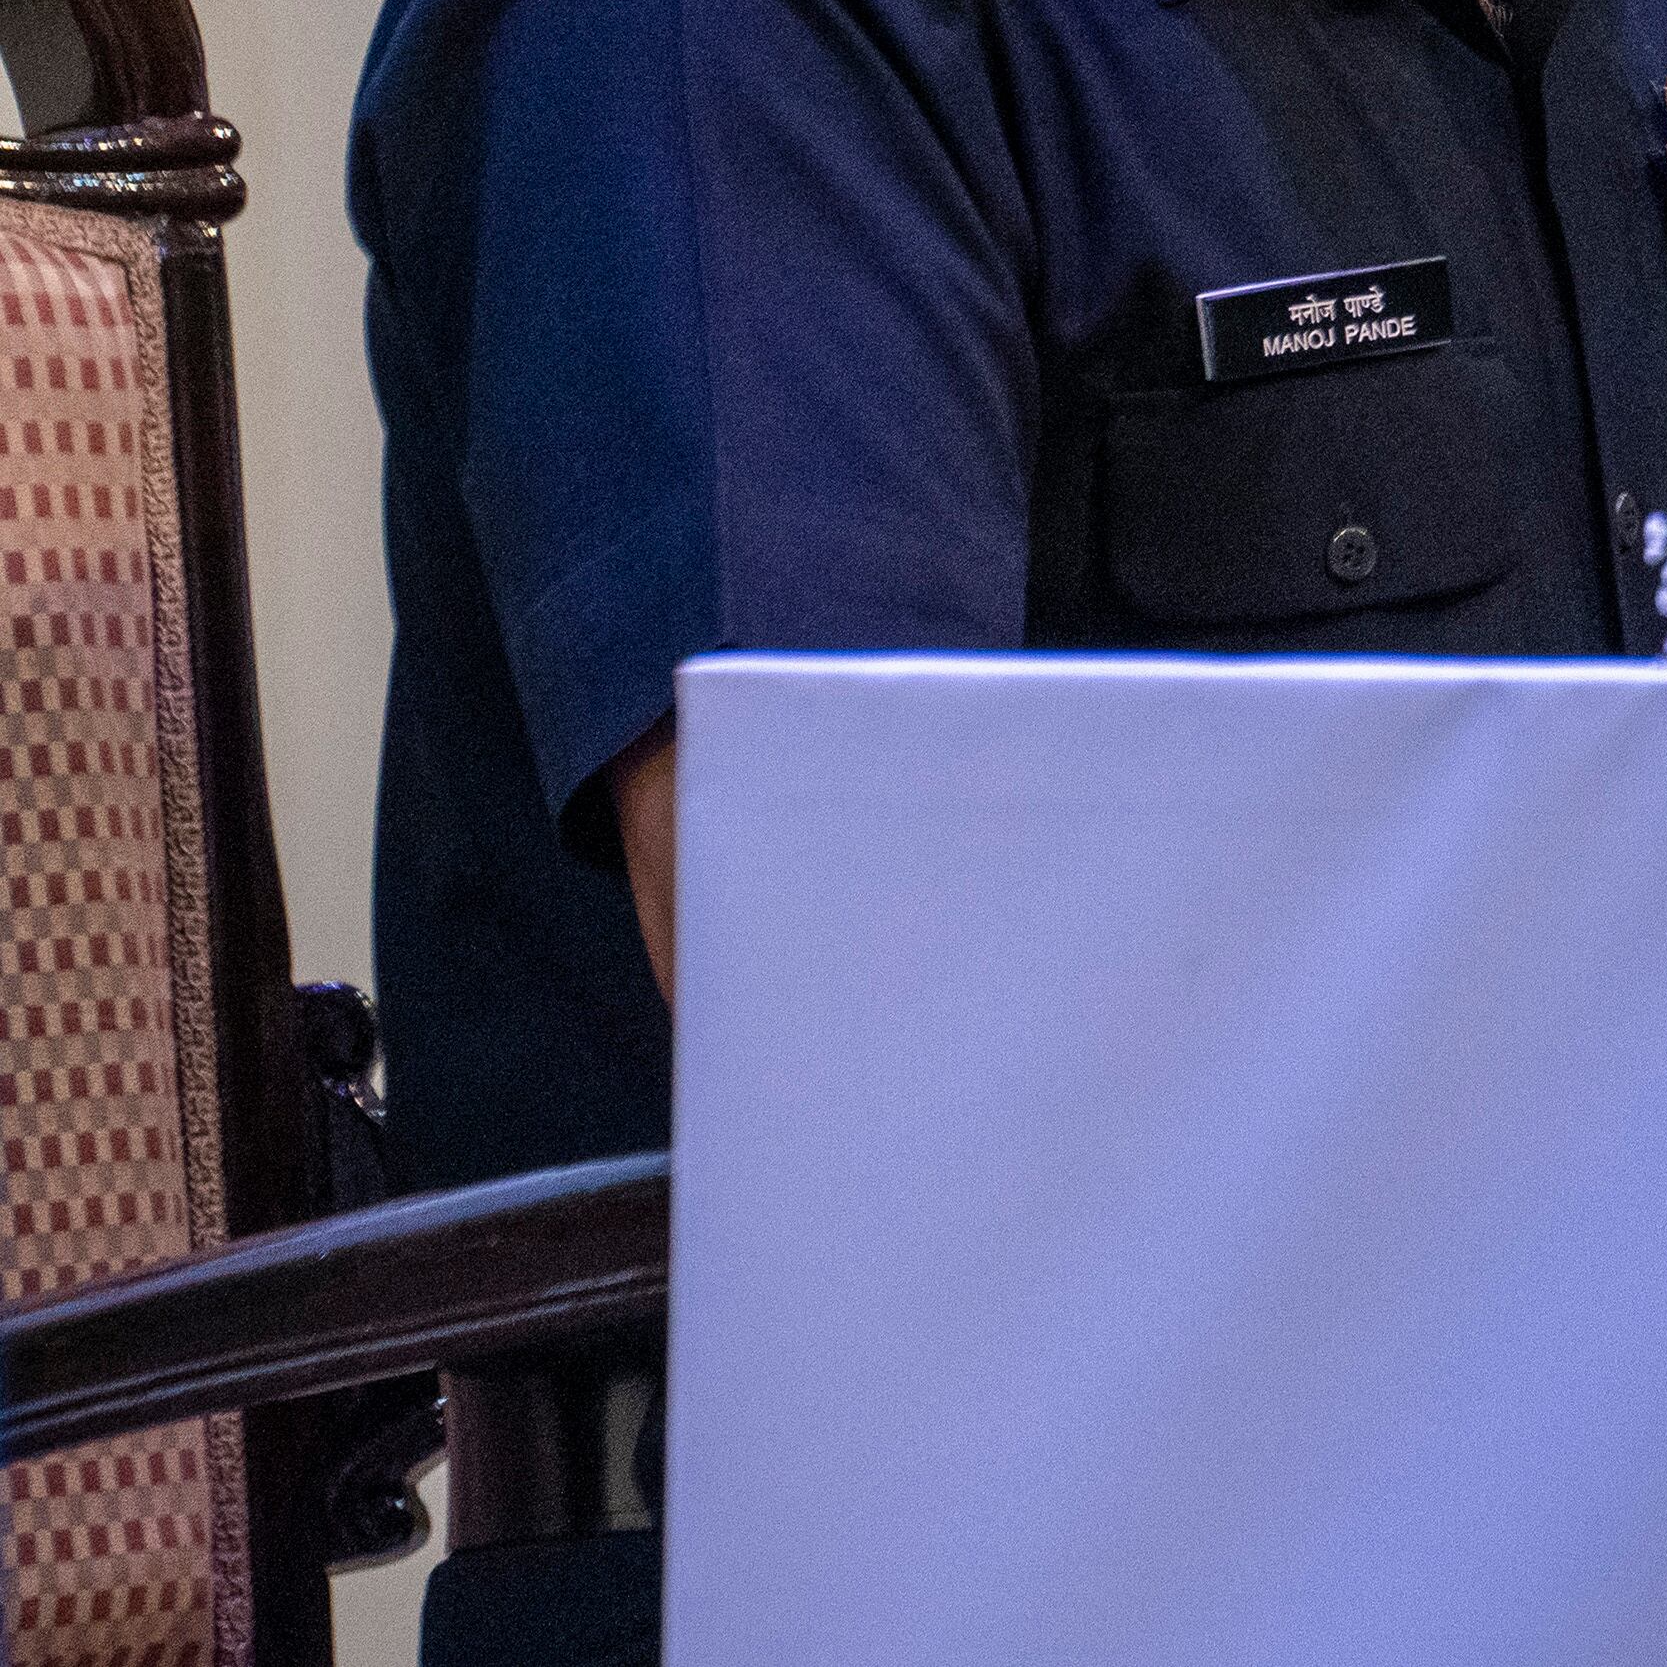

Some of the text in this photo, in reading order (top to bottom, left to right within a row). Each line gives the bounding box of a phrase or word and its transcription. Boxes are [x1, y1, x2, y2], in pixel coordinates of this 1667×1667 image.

[1288, 294, 1336, 326] मनोज
[1263, 315, 1418, 357] MANOJ PANDE
